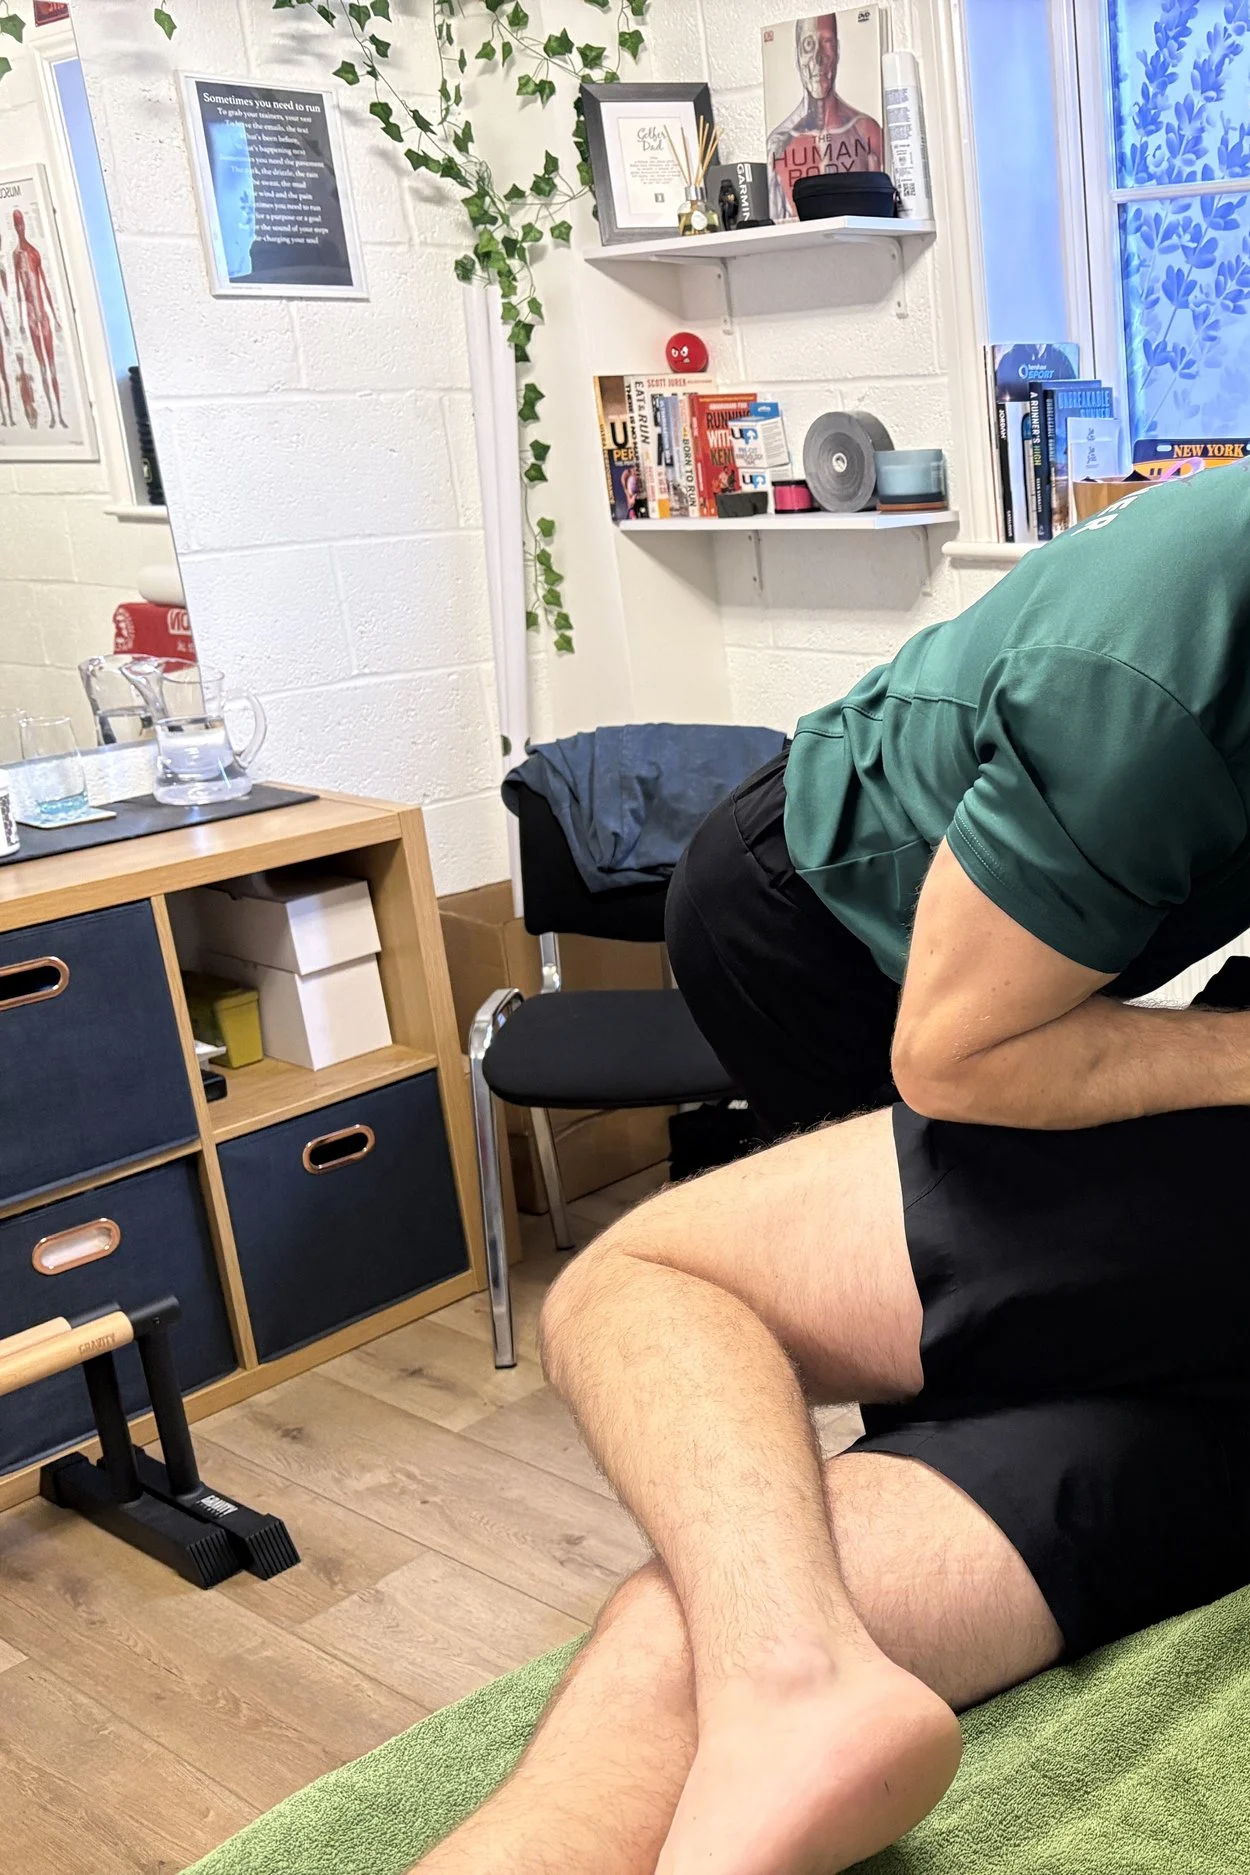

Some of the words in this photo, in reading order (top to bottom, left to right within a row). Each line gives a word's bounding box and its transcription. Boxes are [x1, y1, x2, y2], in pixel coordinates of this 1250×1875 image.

[203, 93, 253, 106] Sometimes
[255, 100, 271, 108] you
[274, 101, 294, 110] need
[295, 103, 304, 111] to
[228, 109, 242, 117] grab
[643, 140, 664, 151] Dad
[813, 134, 832, 142] THE
[773, 136, 871, 170] HUMAN
[737, 163, 750, 221] GARMIN
[1028, 370, 1055, 379] SPORT
[635, 381, 644, 403] EAT
[1058, 391, 1110, 408] UNBREAKABLE
[638, 414, 650, 445] RUN
[1031, 400, 1040, 443] RUNNER'S
[683, 439, 691, 466] BORN
[1033, 445, 1041, 466] HIGH
[1173, 445, 1204, 458] NEW
[1207, 444, 1245, 457] YORK
[686, 470, 693, 484] TO
[686, 487, 696, 507] RUN
[78, 1333, 117, 1355] GRAVITY
